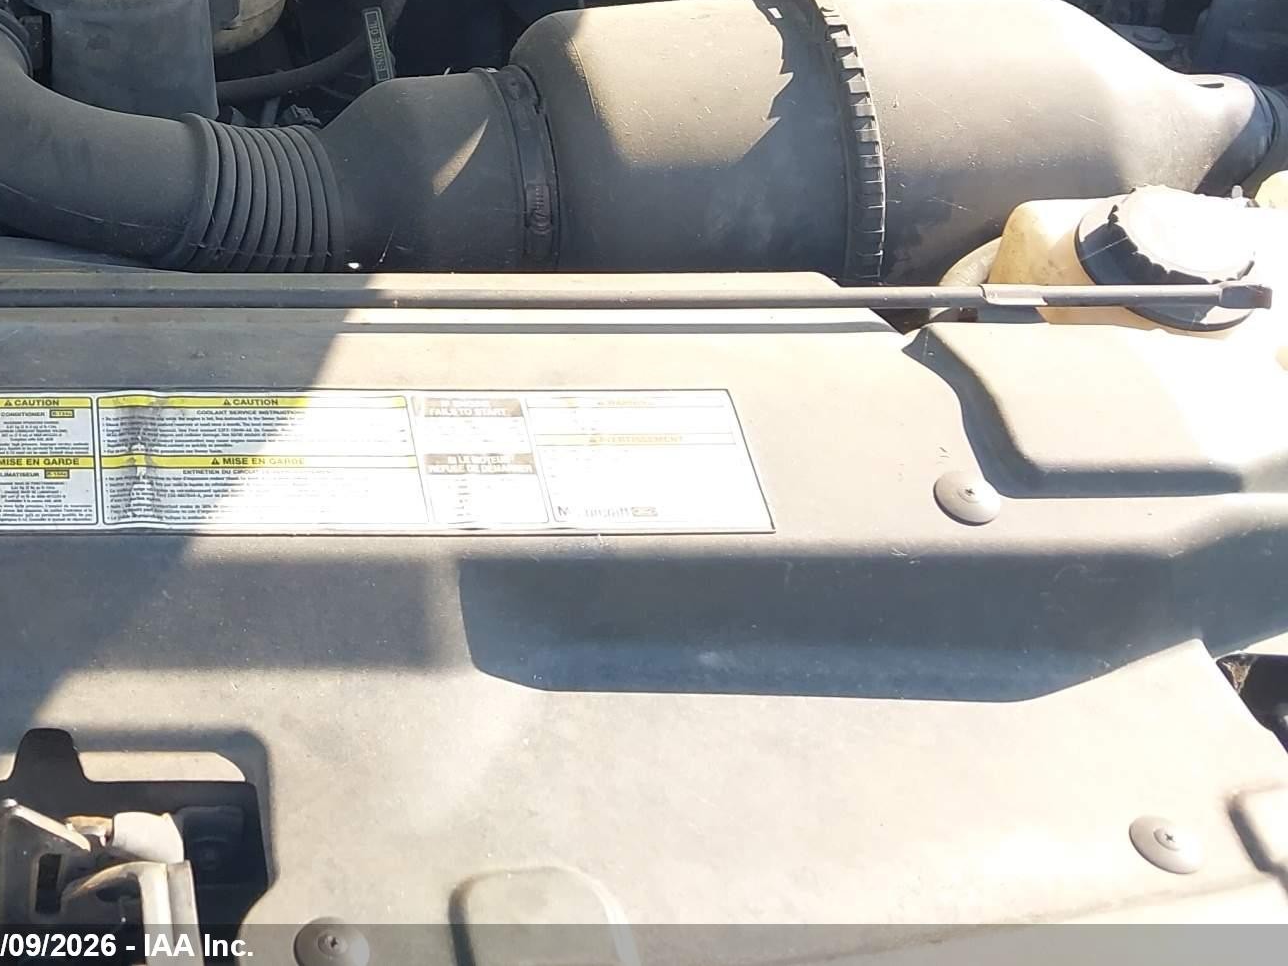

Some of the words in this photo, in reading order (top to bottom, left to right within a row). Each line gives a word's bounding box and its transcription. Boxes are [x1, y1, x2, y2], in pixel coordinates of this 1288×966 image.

[370, 20, 380, 35] OIL
[372, 35, 387, 72] ENGINE
[26, 458, 40, 466] EN
[43, 458, 80, 466] GARDE
[222, 457, 249, 465] MISE
[251, 457, 266, 465] EN
